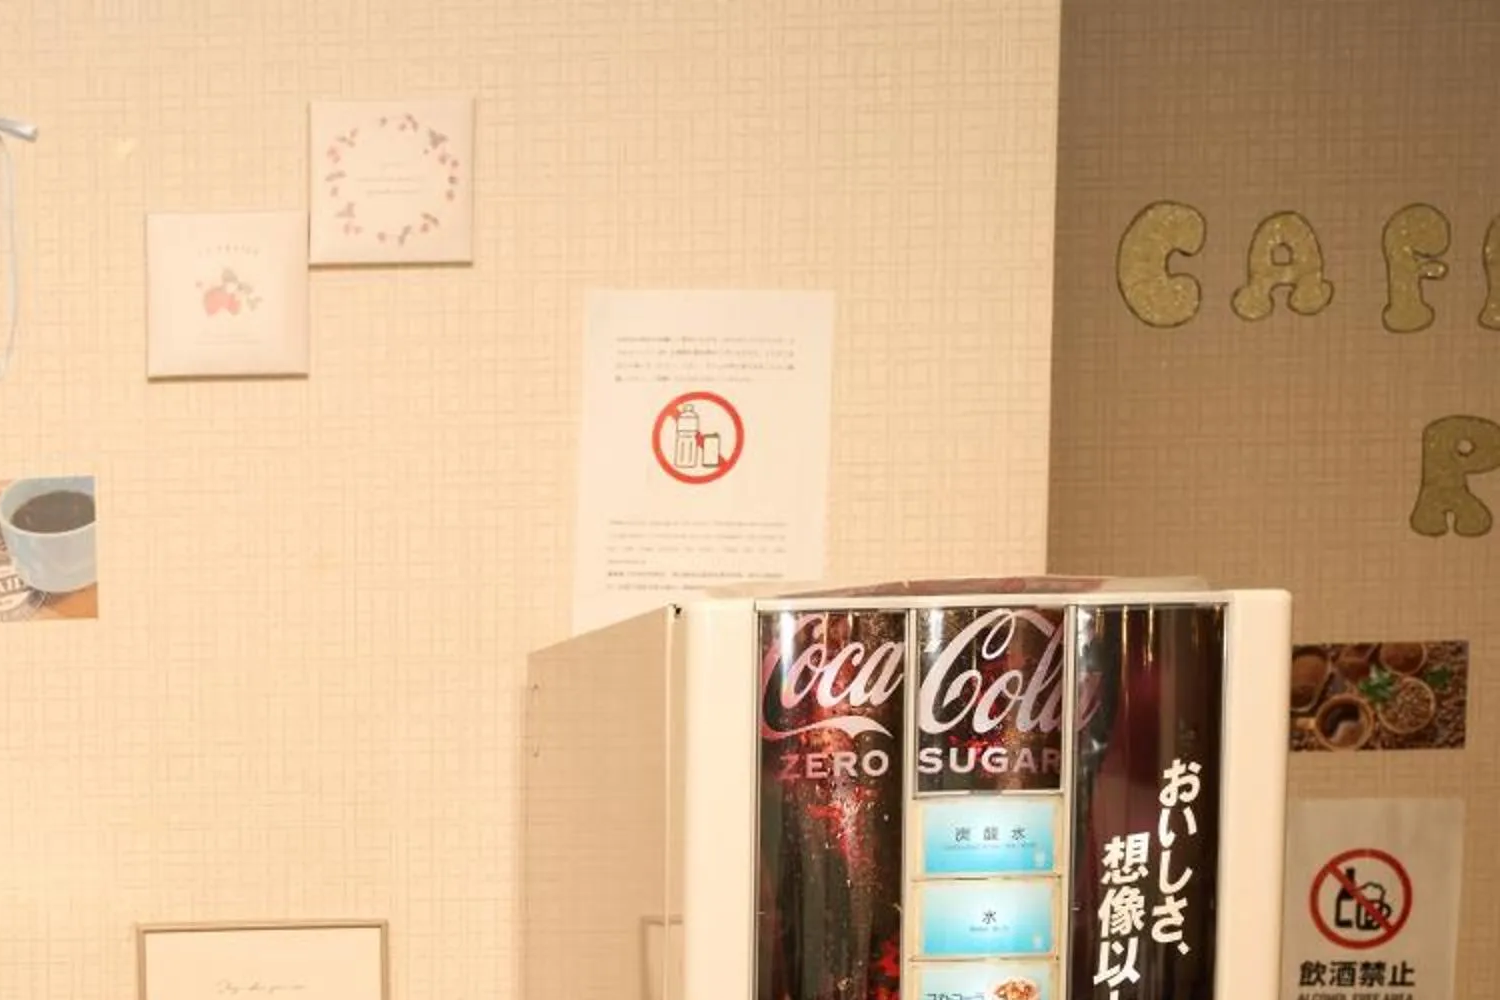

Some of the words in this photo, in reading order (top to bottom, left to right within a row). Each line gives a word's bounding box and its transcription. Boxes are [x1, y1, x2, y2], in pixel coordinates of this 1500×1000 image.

[1117, 200, 1500, 333] CAF
[760, 612, 905, 742] Coca
[778, 750, 889, 780] ZERO
[918, 747, 1060, 773] SUGAR
[981, 910, 997, 924] 水
[1298, 960, 1416, 987] 飲酒禁止
